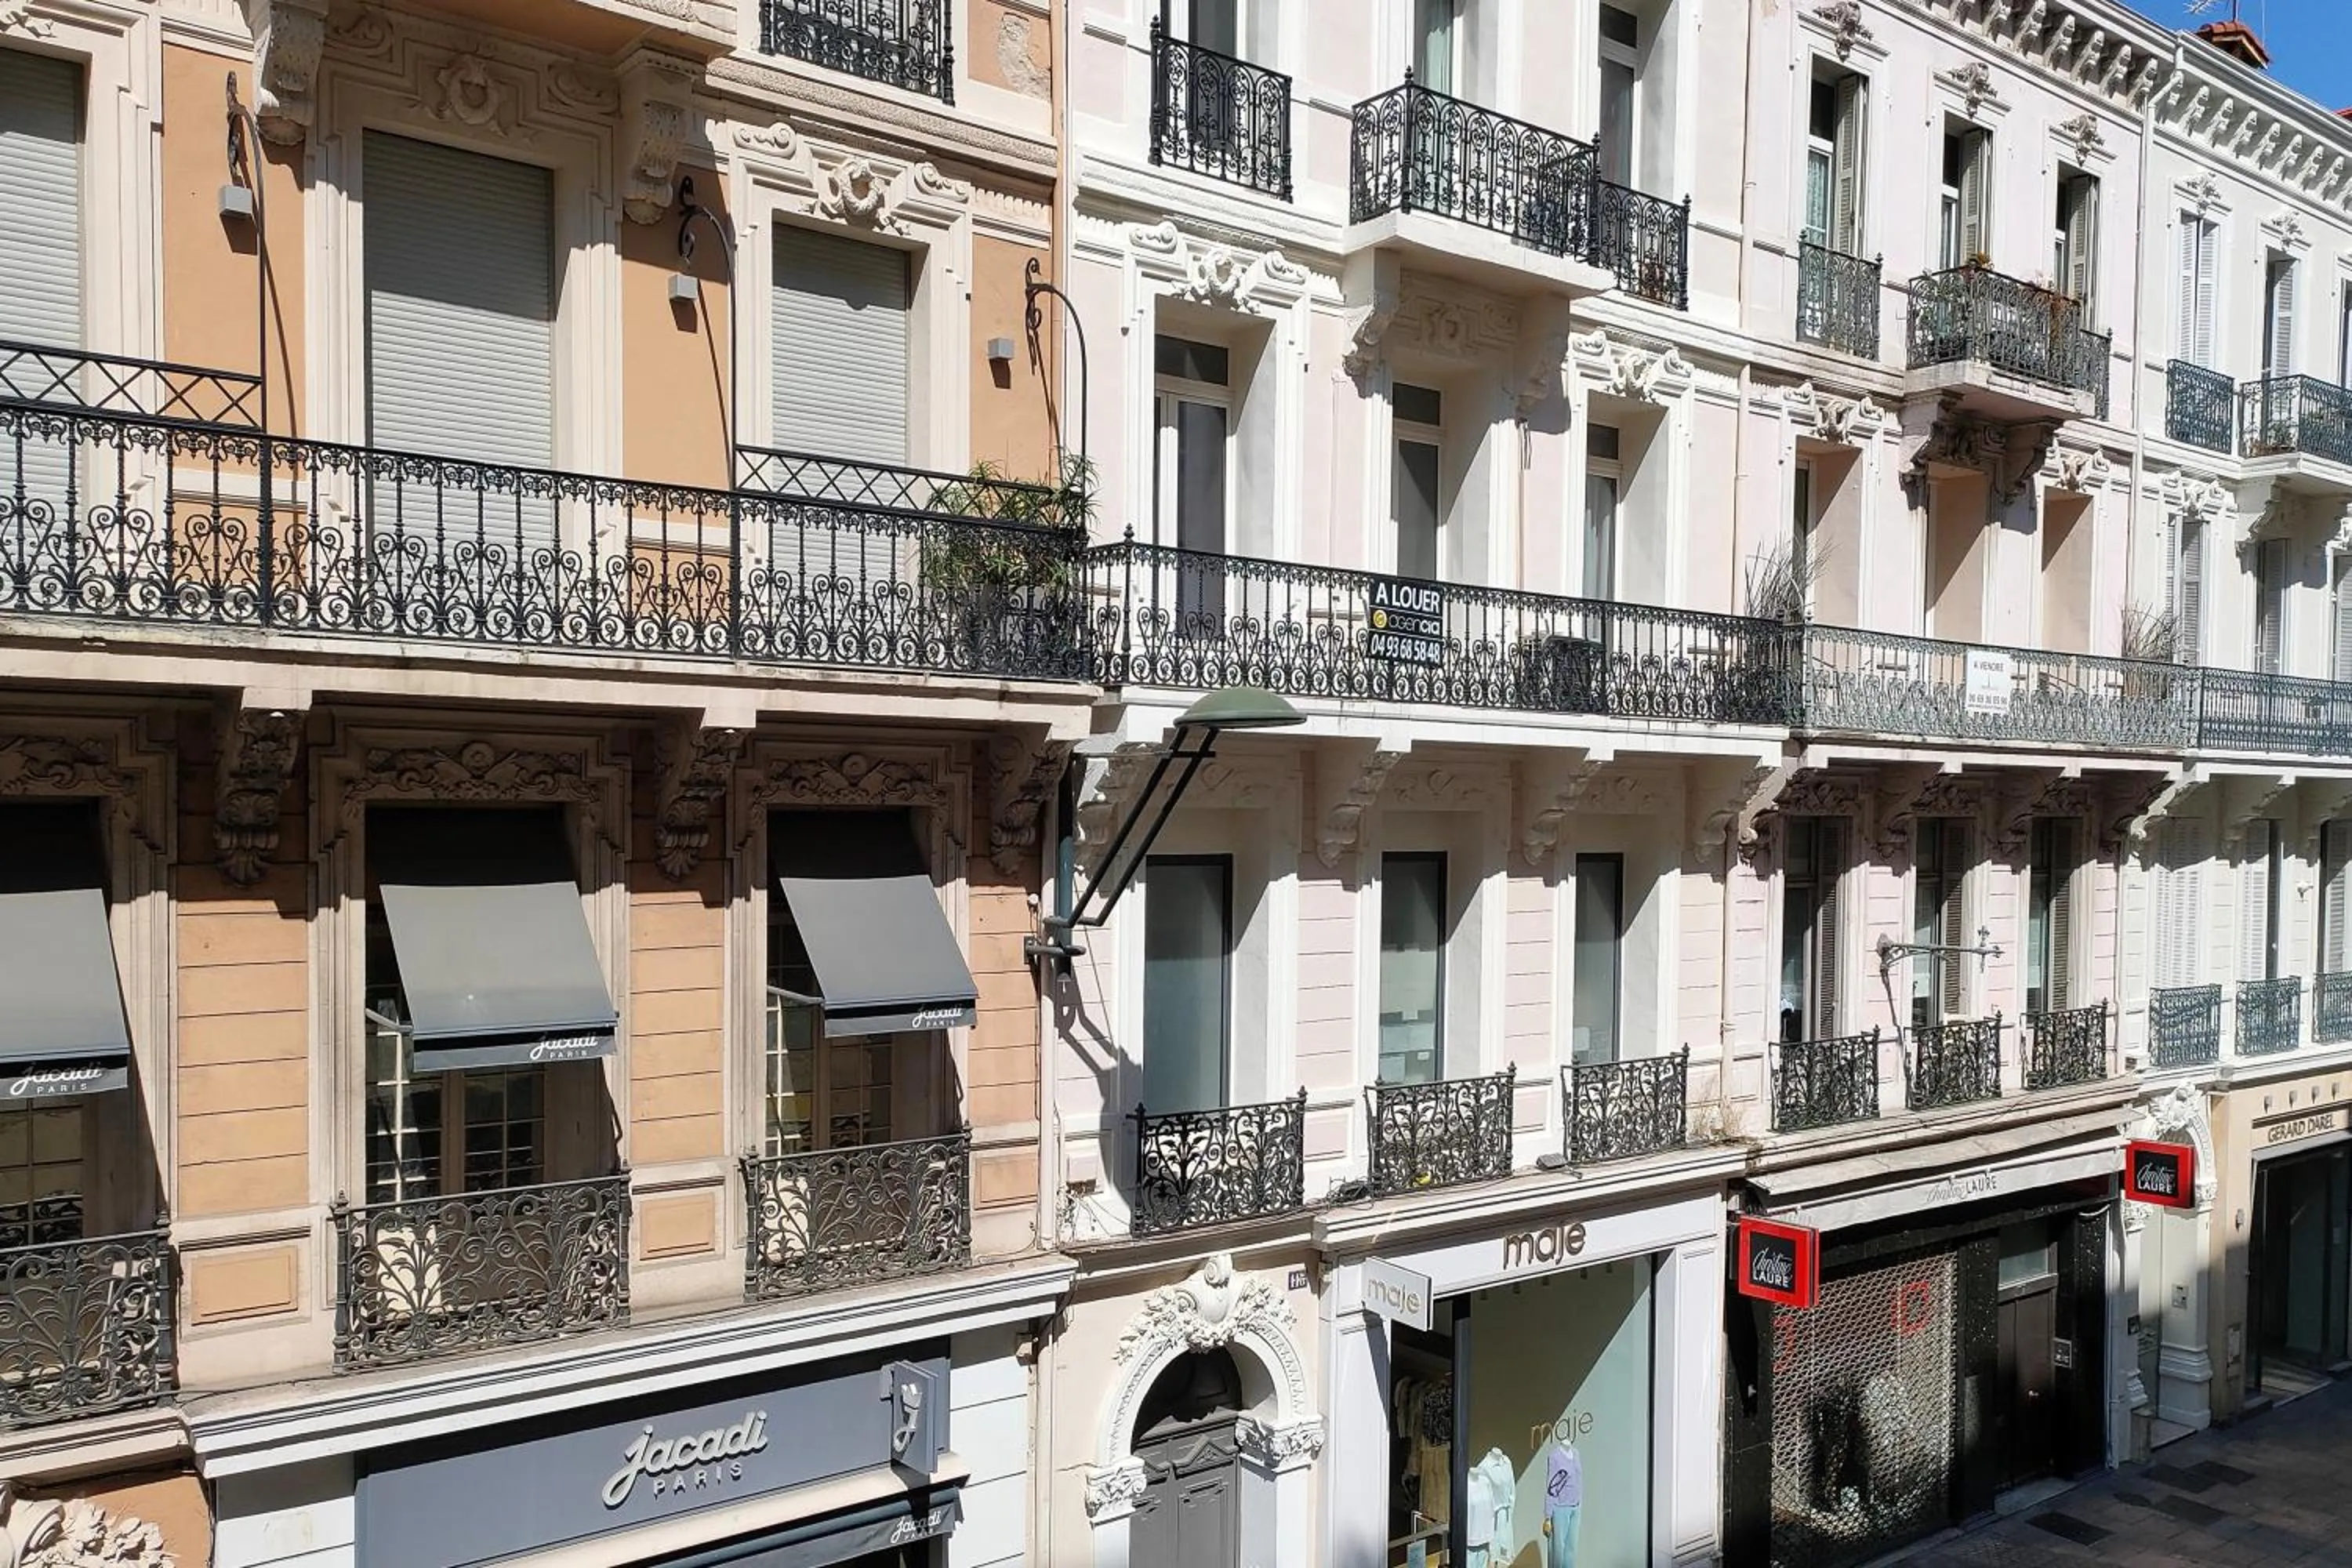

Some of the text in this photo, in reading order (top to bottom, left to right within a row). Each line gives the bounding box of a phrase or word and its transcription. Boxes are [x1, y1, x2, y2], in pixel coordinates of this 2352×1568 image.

[1375, 583, 1440, 614] A LOUER
[1371, 633, 1385, 656] 04
[1386, 636, 1399, 658] 93
[1414, 640, 1426, 661] 58
[1428, 642, 1440, 664] 48
[37, 1083, 87, 1094] PARIS
[1965, 1175, 1997, 1194] LAURE
[2138, 1179, 2172, 1194] LAURE
[1503, 1222, 1586, 1270] maje
[1752, 1267, 1789, 1288] LAURE
[1367, 1279, 1421, 1315] maje
[1531, 1409, 1594, 1450] maje
[652, 1461, 742, 1501] PARIS
